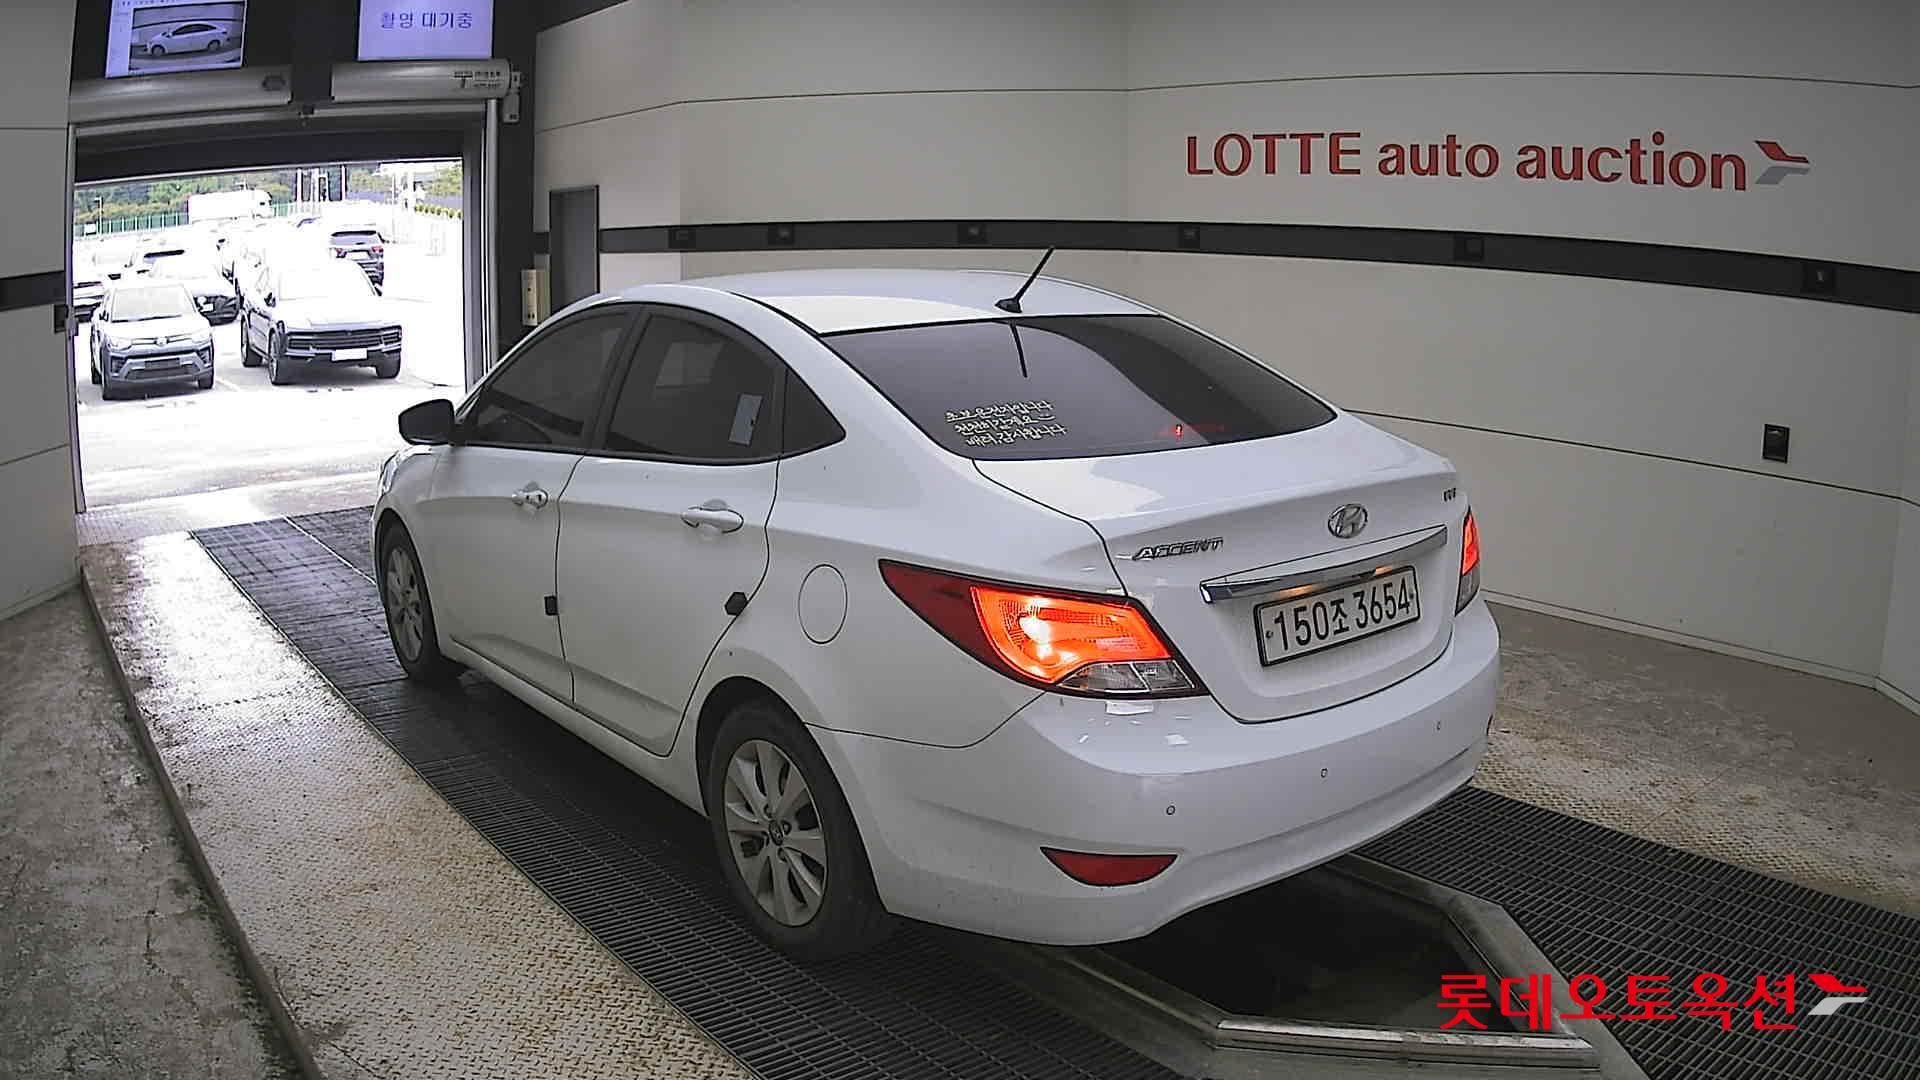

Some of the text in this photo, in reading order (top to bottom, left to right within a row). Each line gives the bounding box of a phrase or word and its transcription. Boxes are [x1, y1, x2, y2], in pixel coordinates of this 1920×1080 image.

[422, 12, 473, 29] 대기중
[1187, 131, 1745, 189] LOTTE auto auction
[1131, 536, 1224, 561] ACCENT
[1274, 578, 1411, 651] 150조 3654
